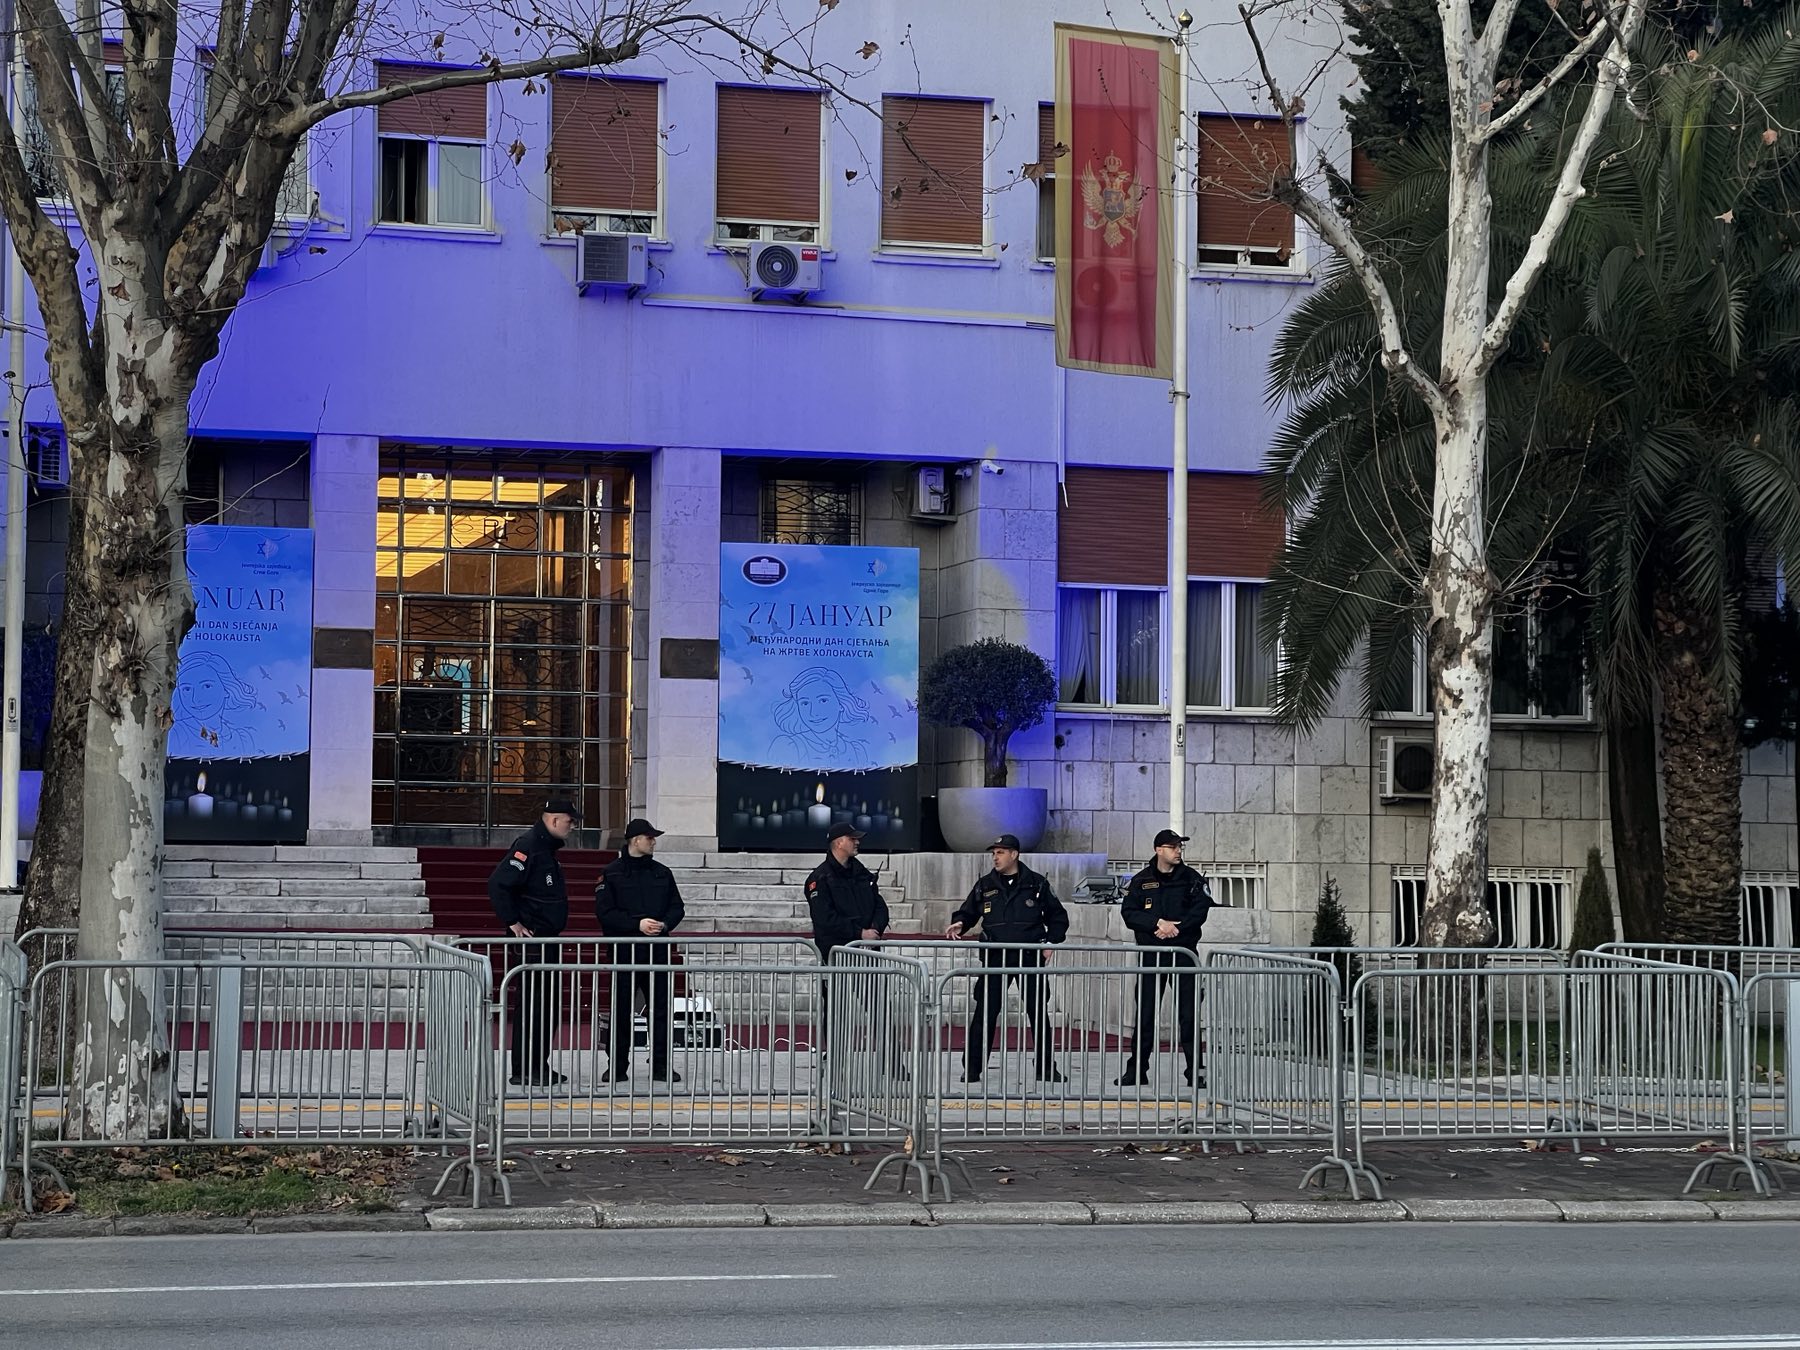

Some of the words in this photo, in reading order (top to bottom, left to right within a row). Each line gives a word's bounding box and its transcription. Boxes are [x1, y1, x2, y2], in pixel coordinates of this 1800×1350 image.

[201, 586, 285, 611] NUAR
[748, 602, 777, 625] 27
[788, 603, 892, 631] ЈАНУАР
[209, 620, 229, 629] DAN
[232, 620, 278, 631] SJEČANJA
[195, 632, 261, 642] HOLOKAUSTA
[750, 635, 822, 645] МЕЂУНАРОДНИ
[824, 637, 844, 646] ДАН
[846, 638, 890, 647] СЈЕЋАЊА
[763, 647, 776, 656] НА
[778, 647, 810, 656] ЖРТВЕ
[813, 649, 874, 658] ХОЛОКАУСТА
